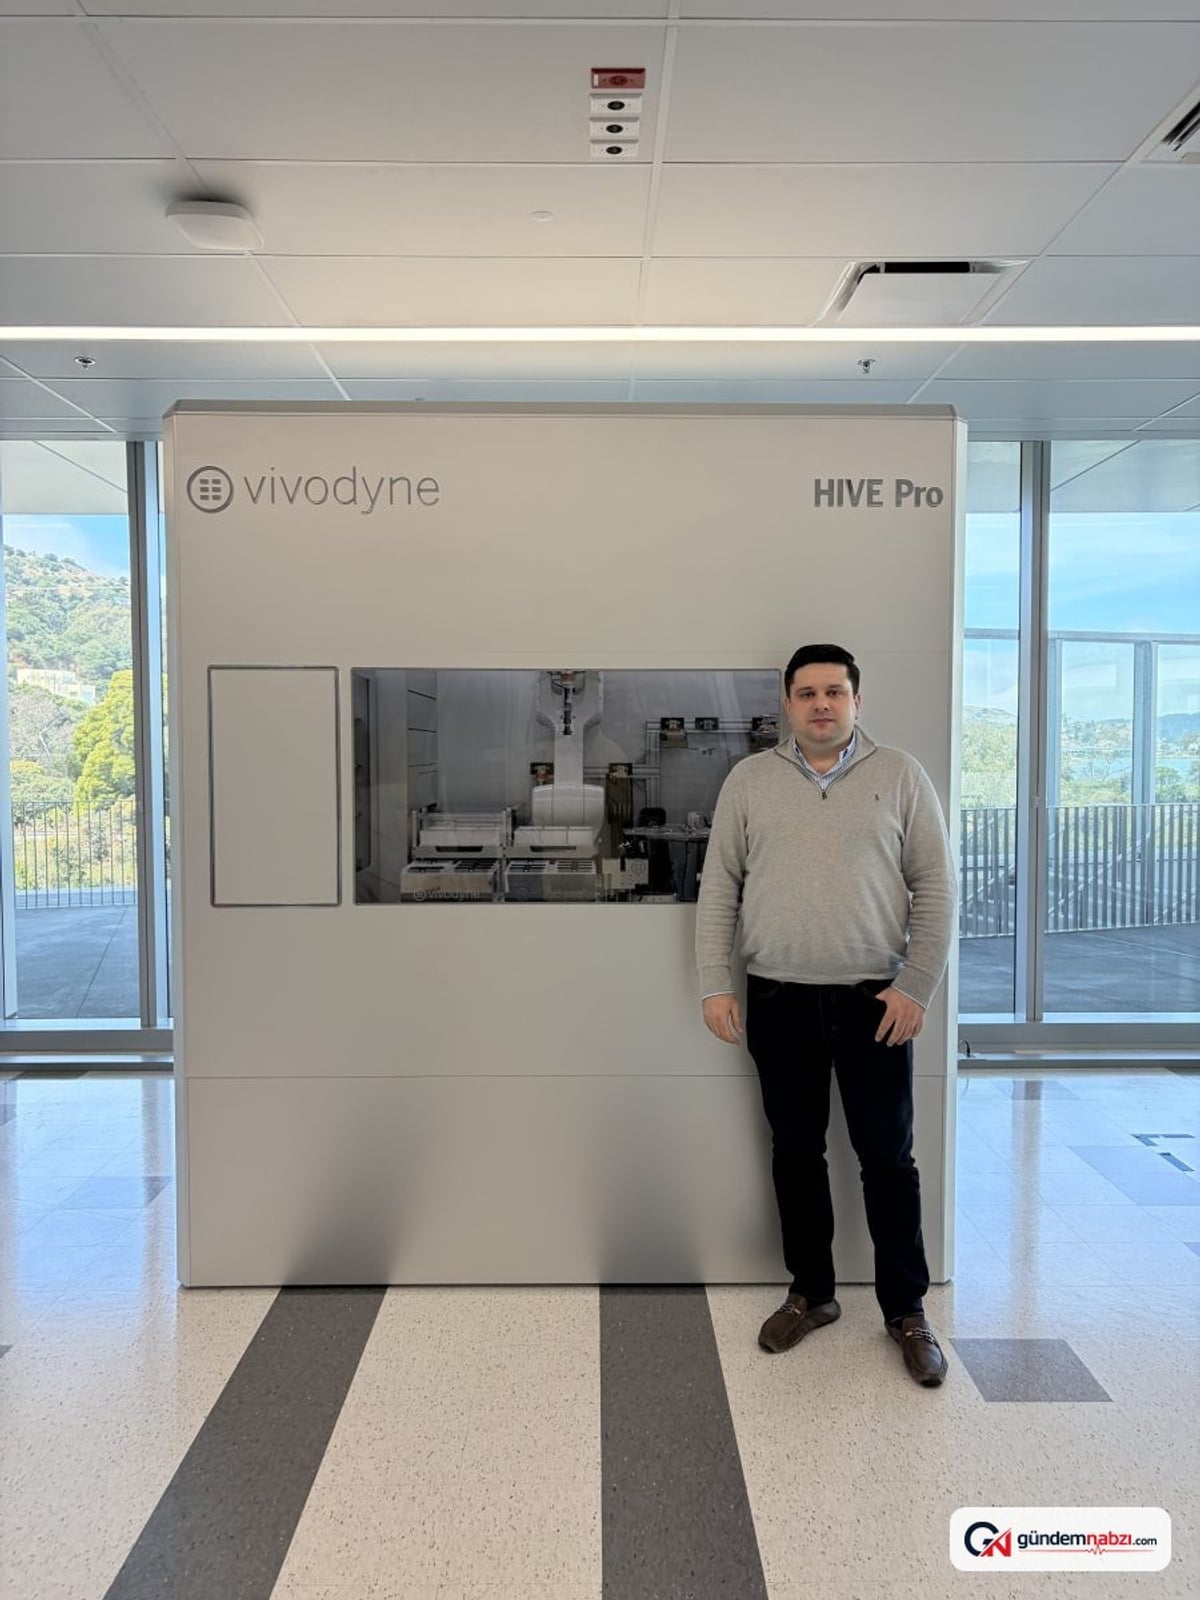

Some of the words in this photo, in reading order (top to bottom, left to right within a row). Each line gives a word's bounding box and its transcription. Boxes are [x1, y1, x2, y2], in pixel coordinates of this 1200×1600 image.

[243, 466, 440, 515] vivodyne
[814, 478, 884, 508] HIVE
[895, 478, 944, 508] Pro
